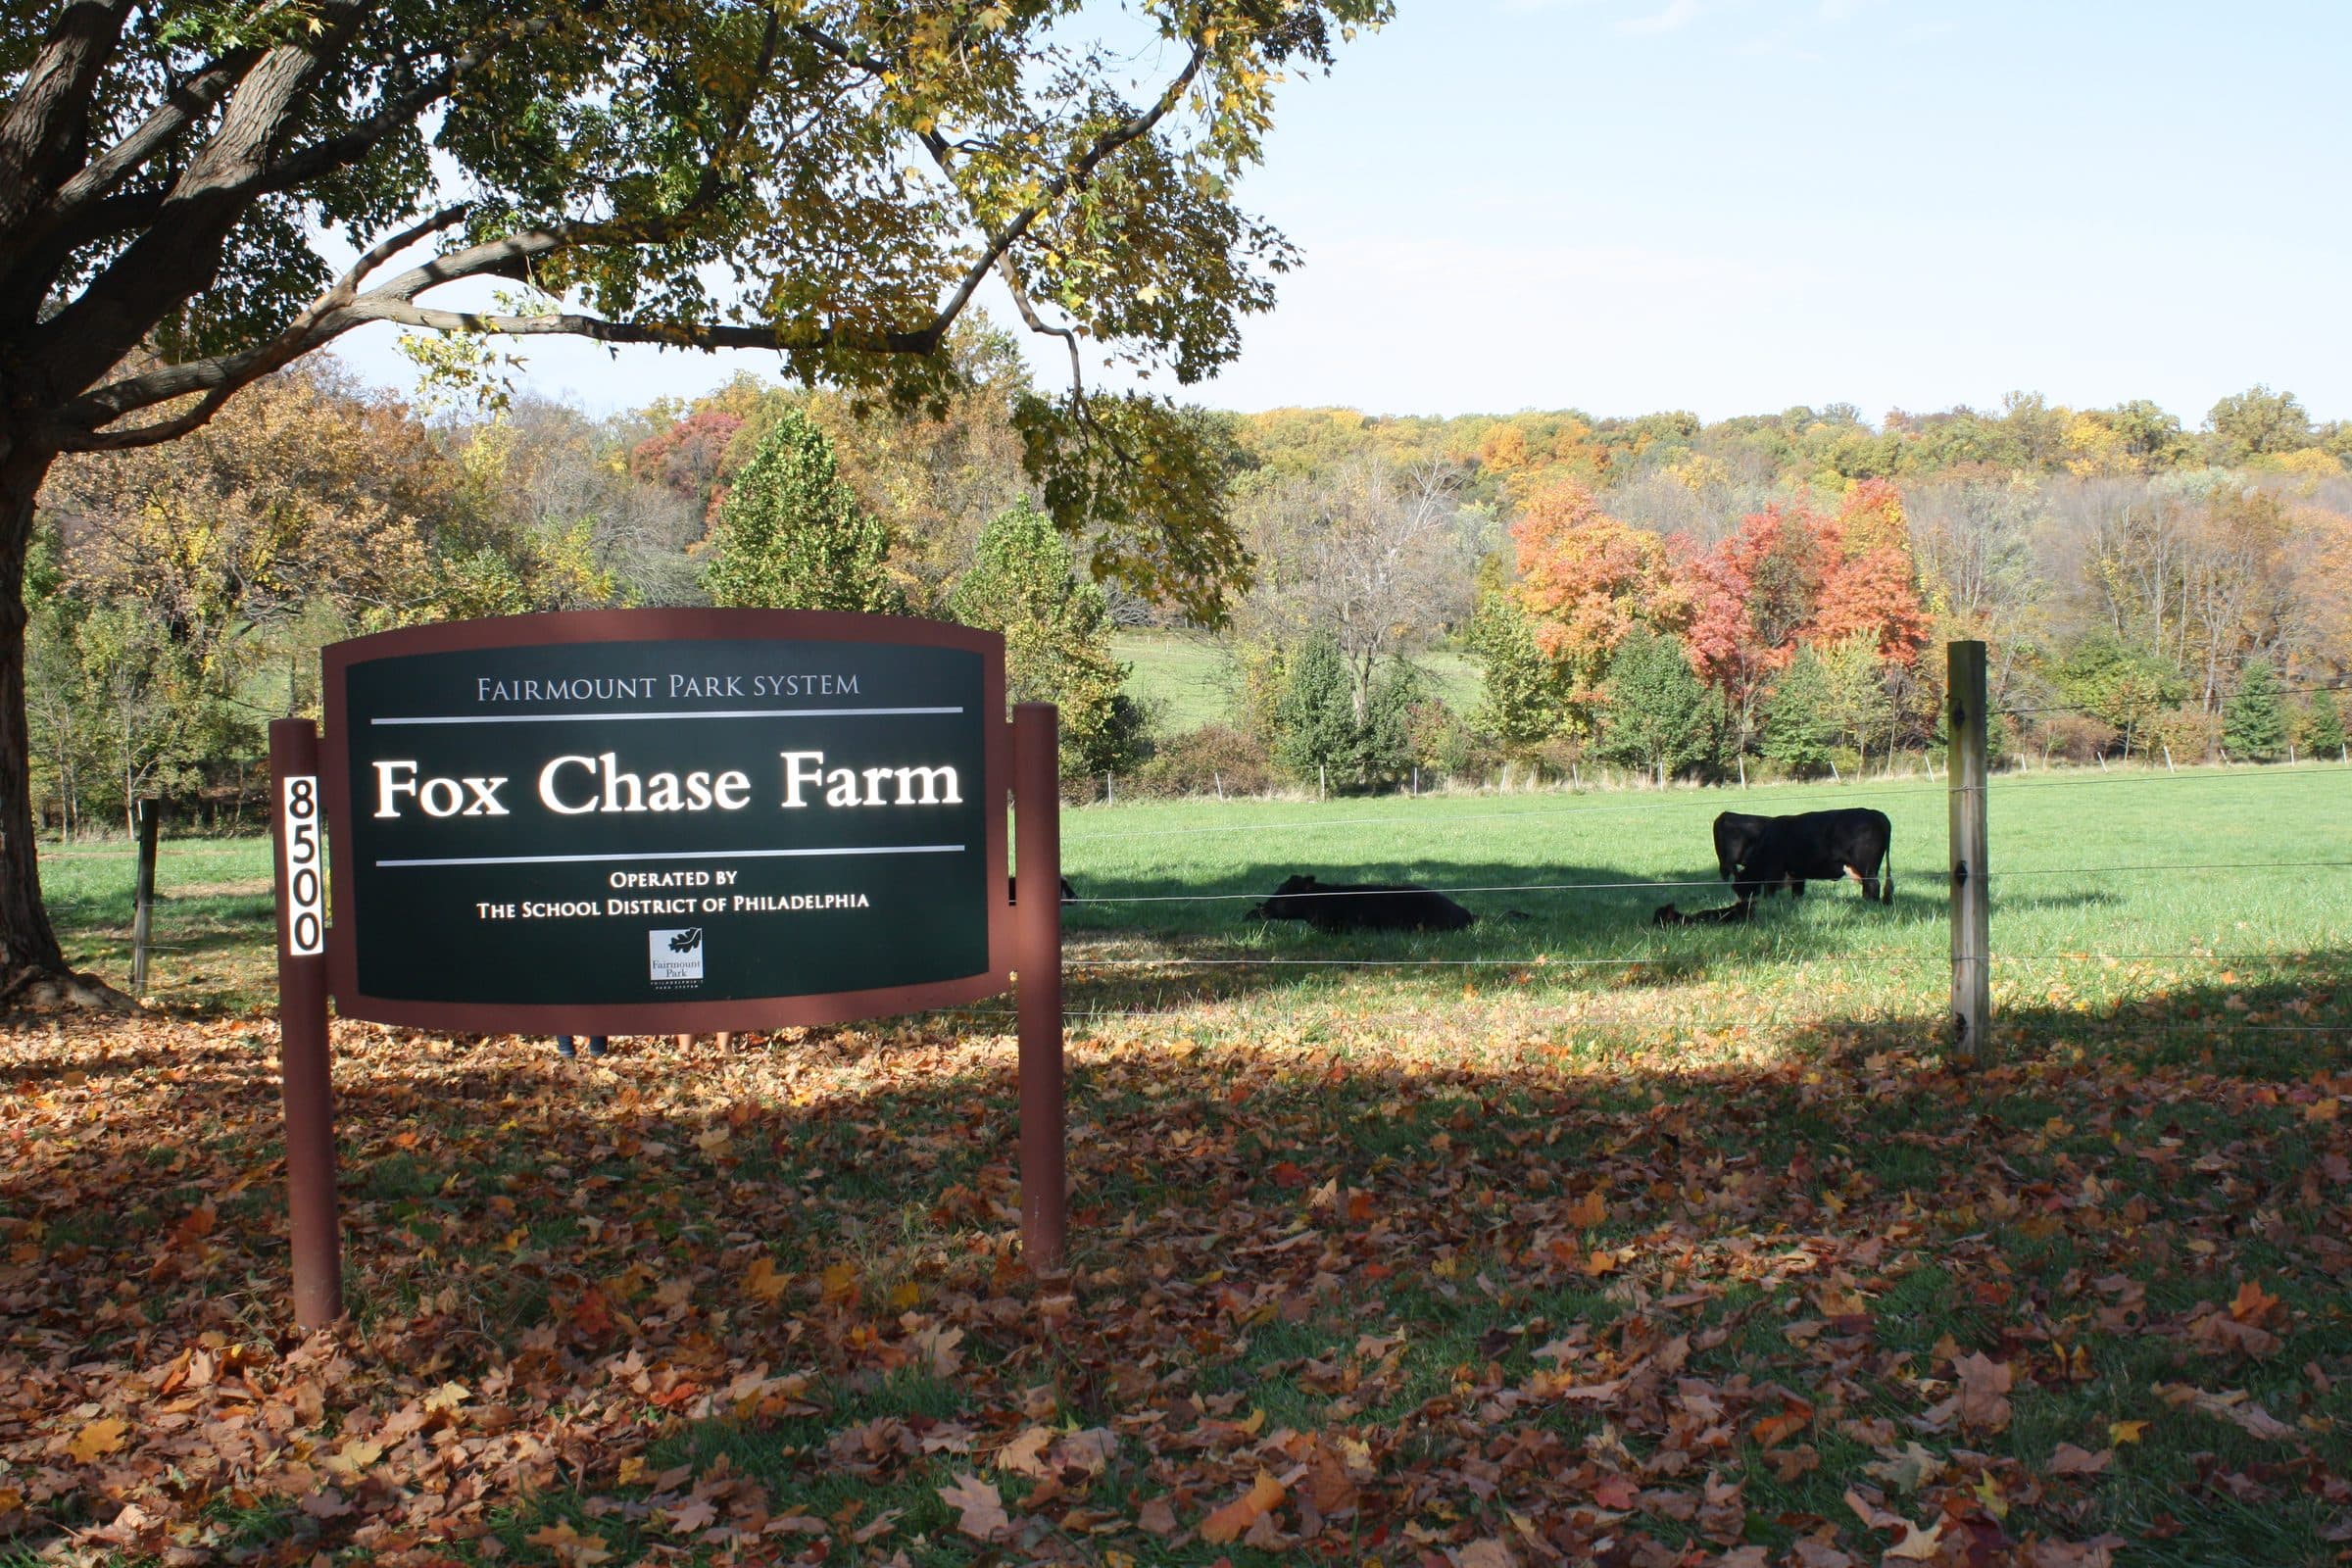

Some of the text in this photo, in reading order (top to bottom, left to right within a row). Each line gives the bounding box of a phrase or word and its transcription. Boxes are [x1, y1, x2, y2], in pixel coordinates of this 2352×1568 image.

[477, 673, 860, 702] FAIRMOUNT PARK SYSTEM
[372, 751, 963, 817] Fox Chase Farm
[289, 779, 319, 951] 8500
[610, 870, 738, 888] OPERATED BY
[476, 893, 870, 919] THE SCHOOL DISTRICT OF PHILADELPHIA
[653, 960, 700, 969] Fairmount
